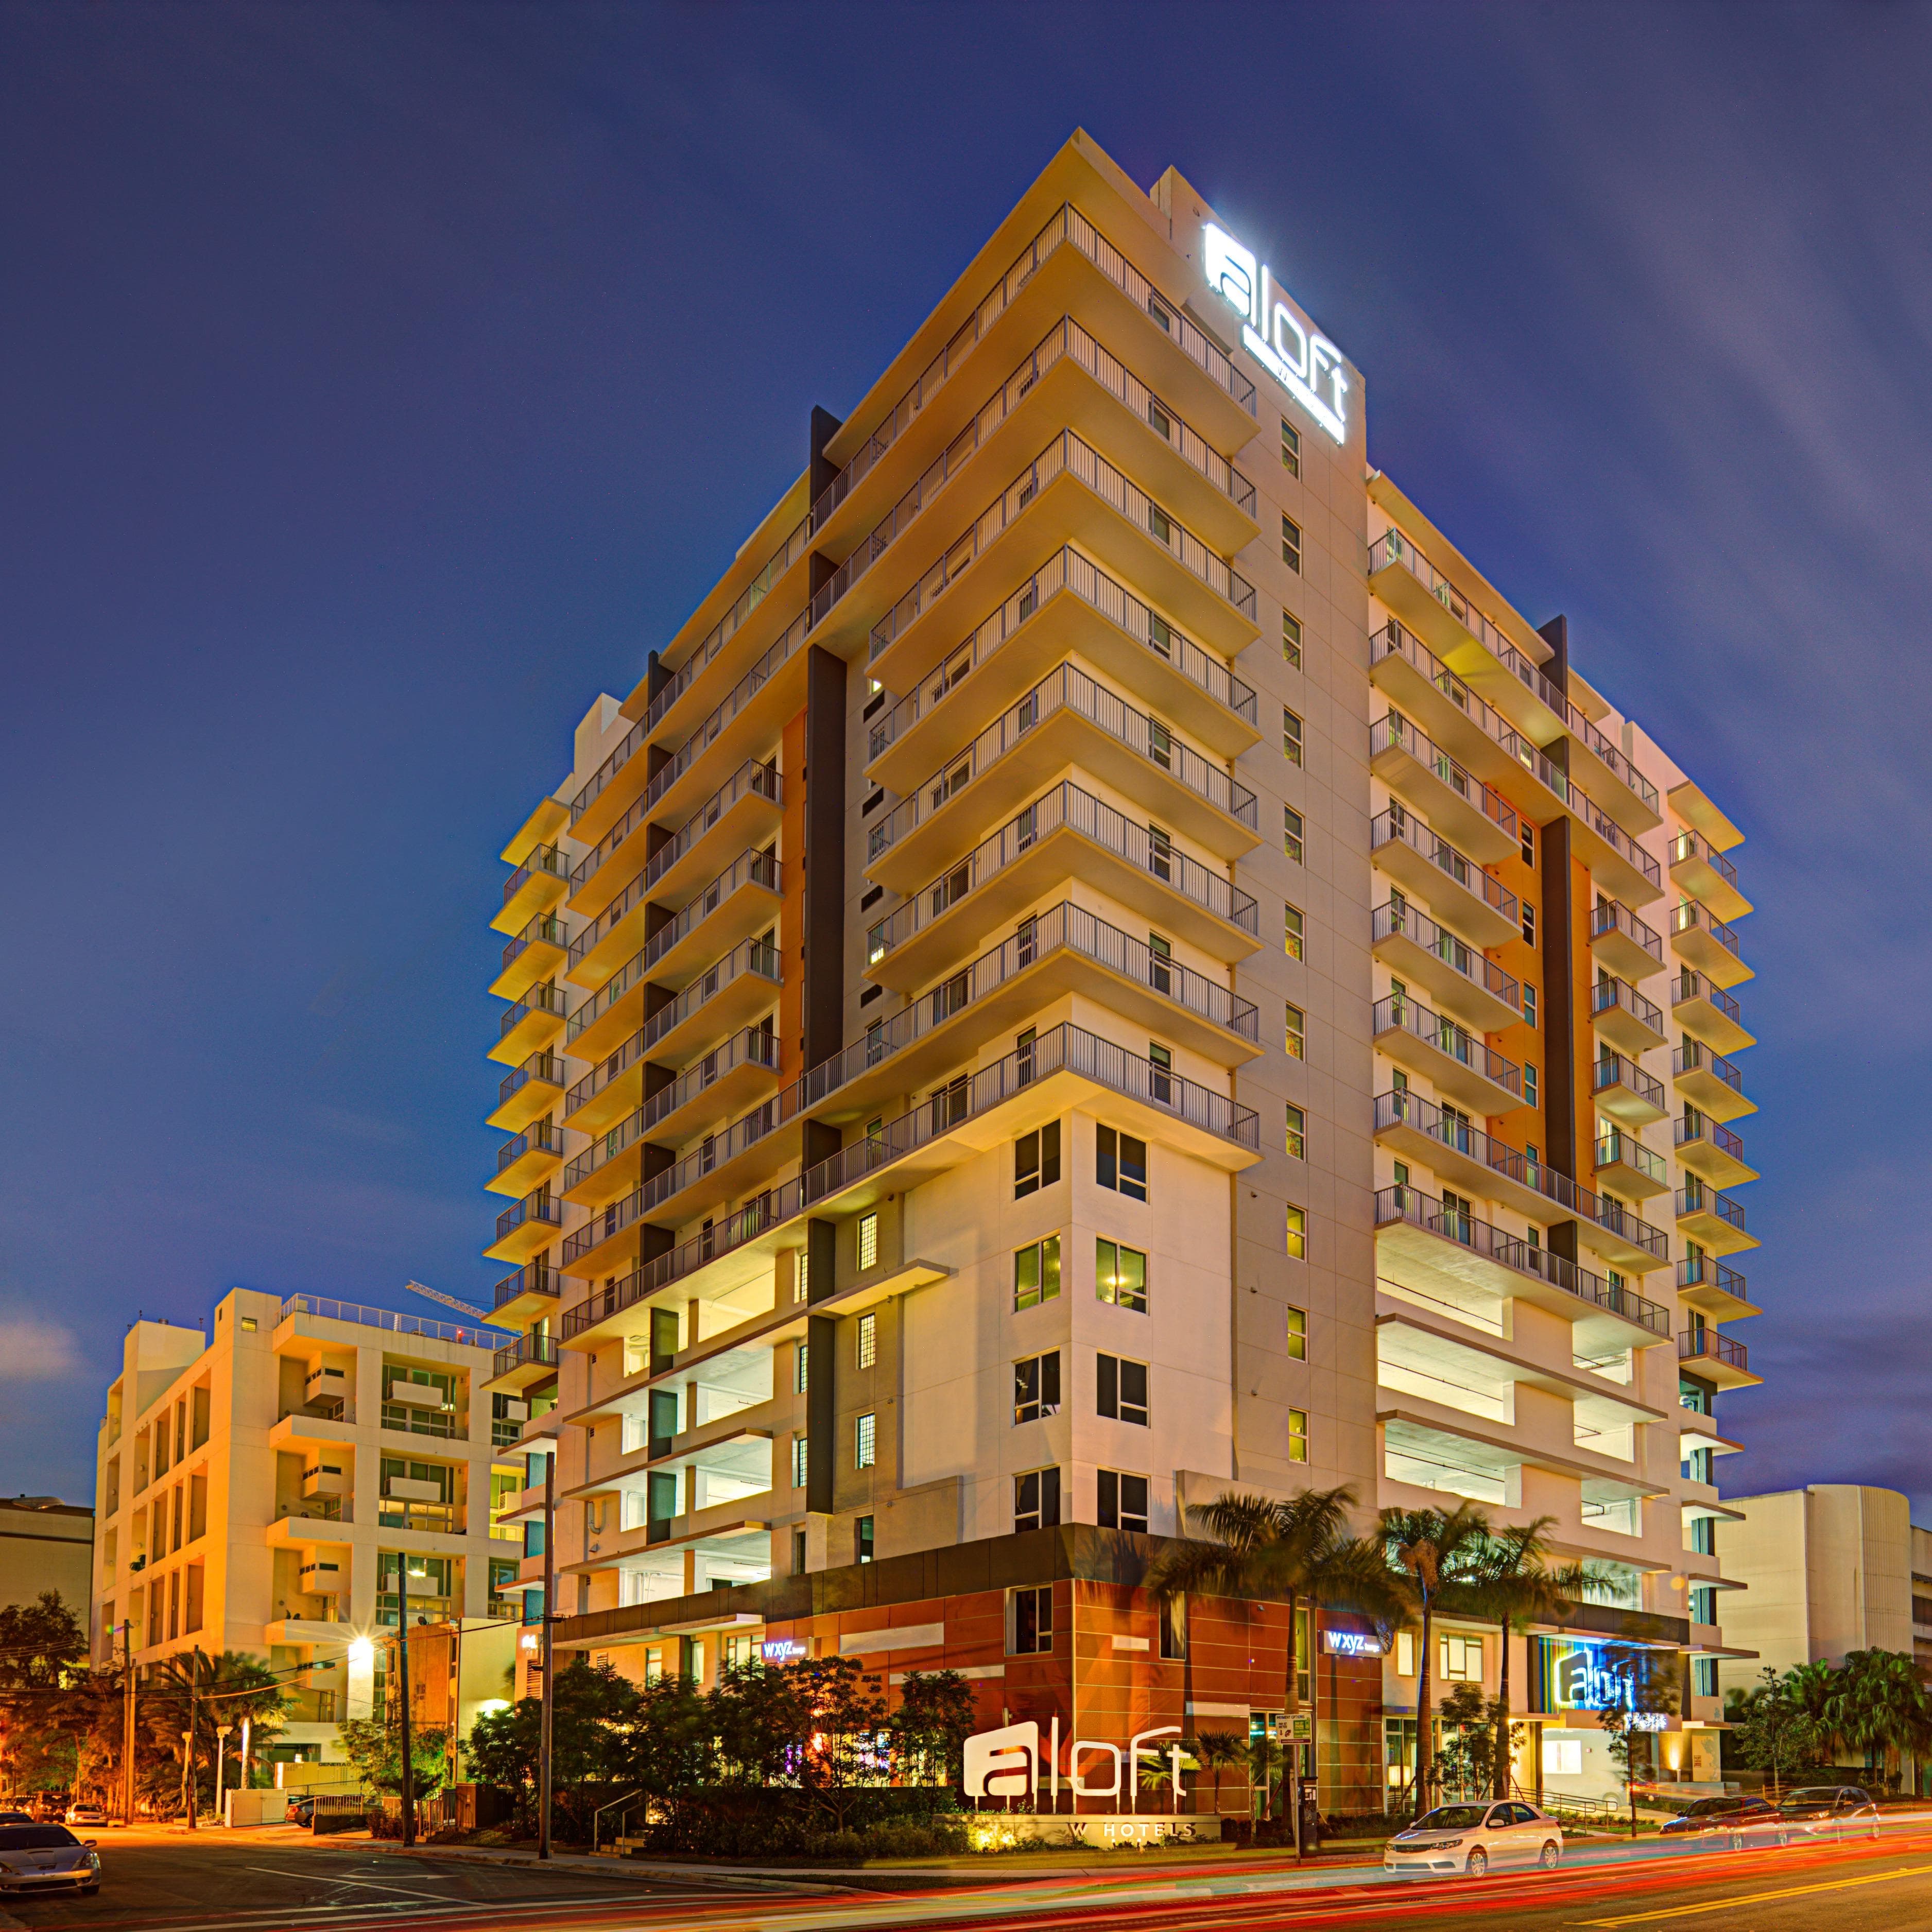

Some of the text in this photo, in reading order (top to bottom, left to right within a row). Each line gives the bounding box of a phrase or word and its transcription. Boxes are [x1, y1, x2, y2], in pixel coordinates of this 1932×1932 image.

[1205, 222, 1348, 422] aloft
[963, 1716, 1191, 1797] aloft
[1070, 1823, 1193, 1837] W HOTELS
